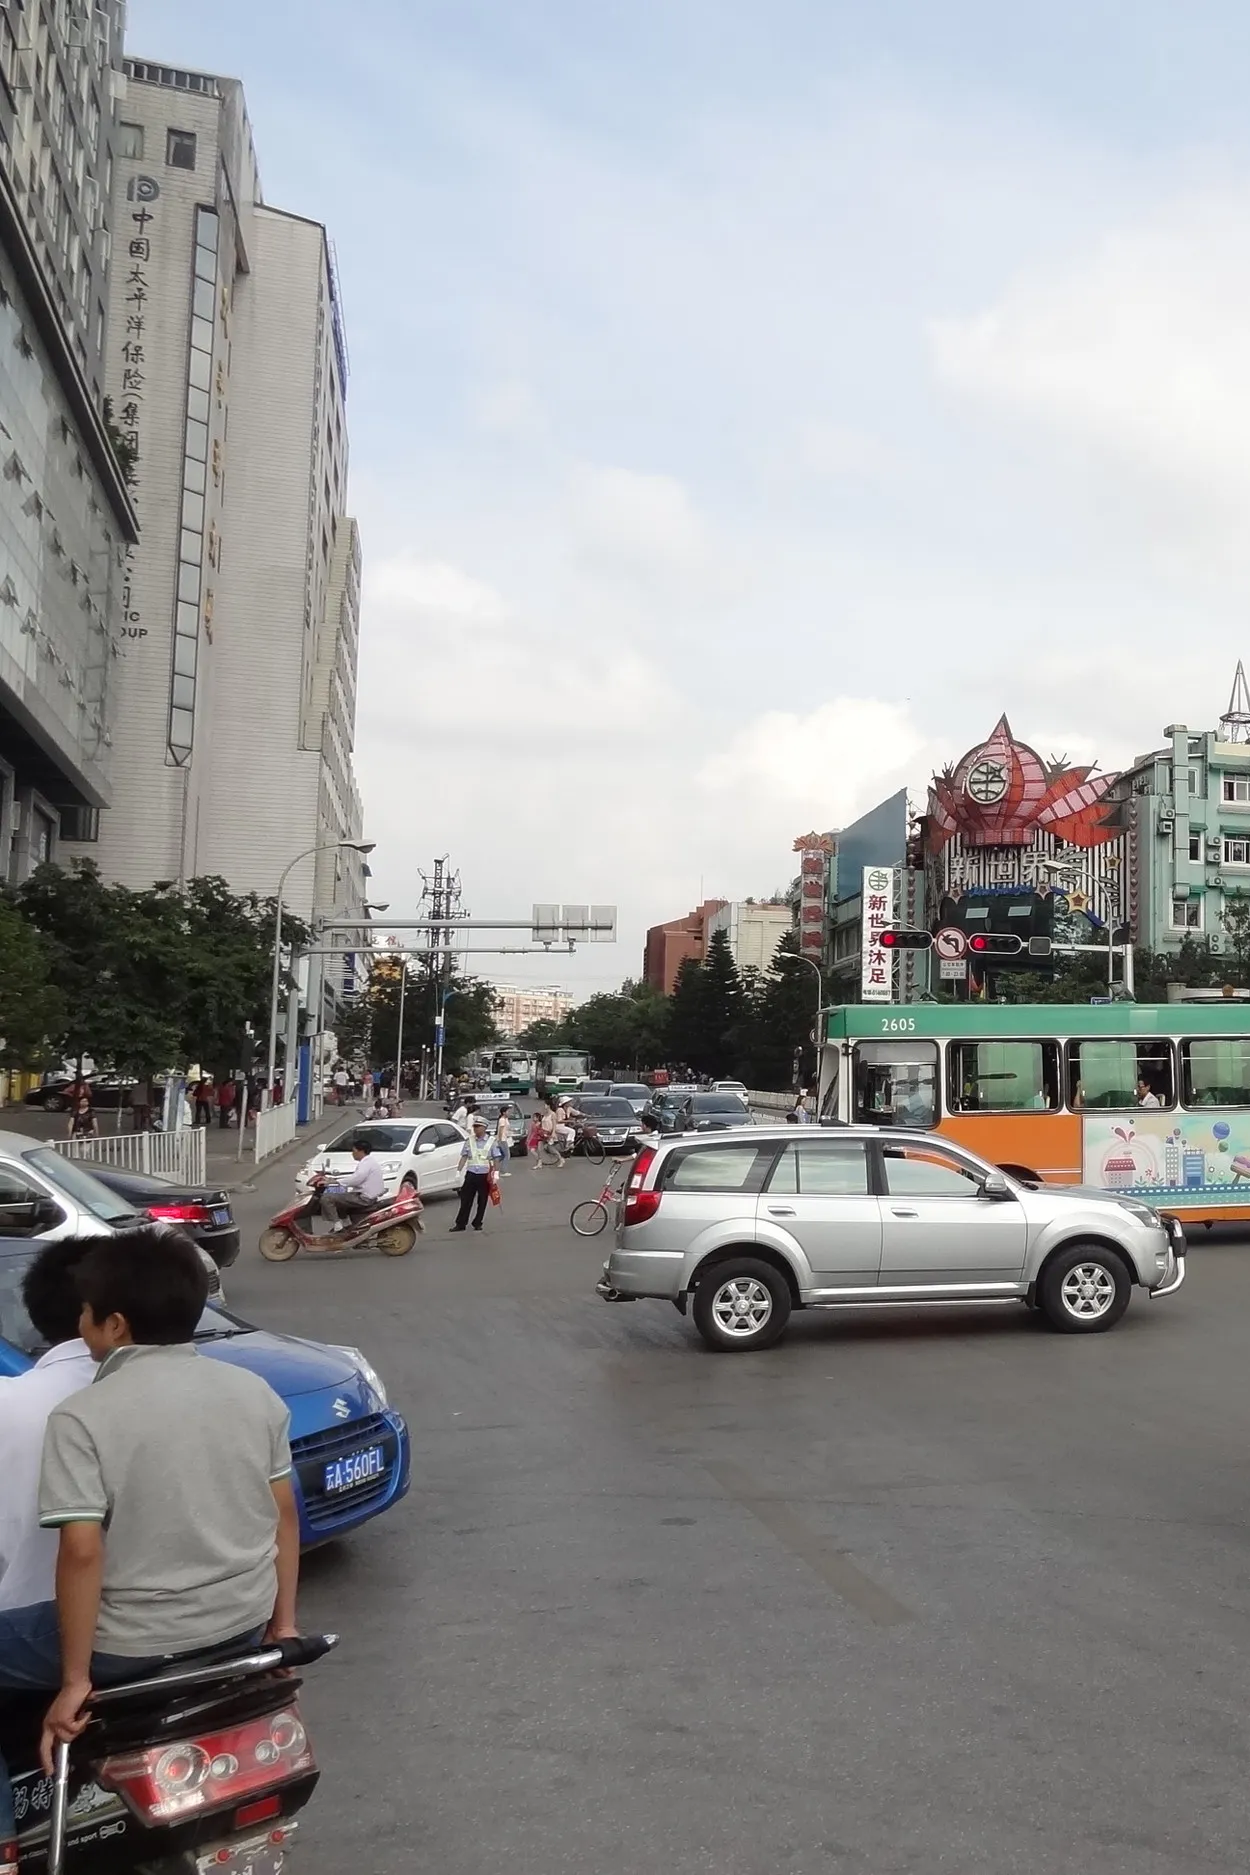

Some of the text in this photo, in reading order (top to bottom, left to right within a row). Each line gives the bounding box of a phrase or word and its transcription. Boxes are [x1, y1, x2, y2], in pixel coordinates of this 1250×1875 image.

[868, 894, 888, 984] 新世界沐足
[881, 1018, 915, 1031] 2605
